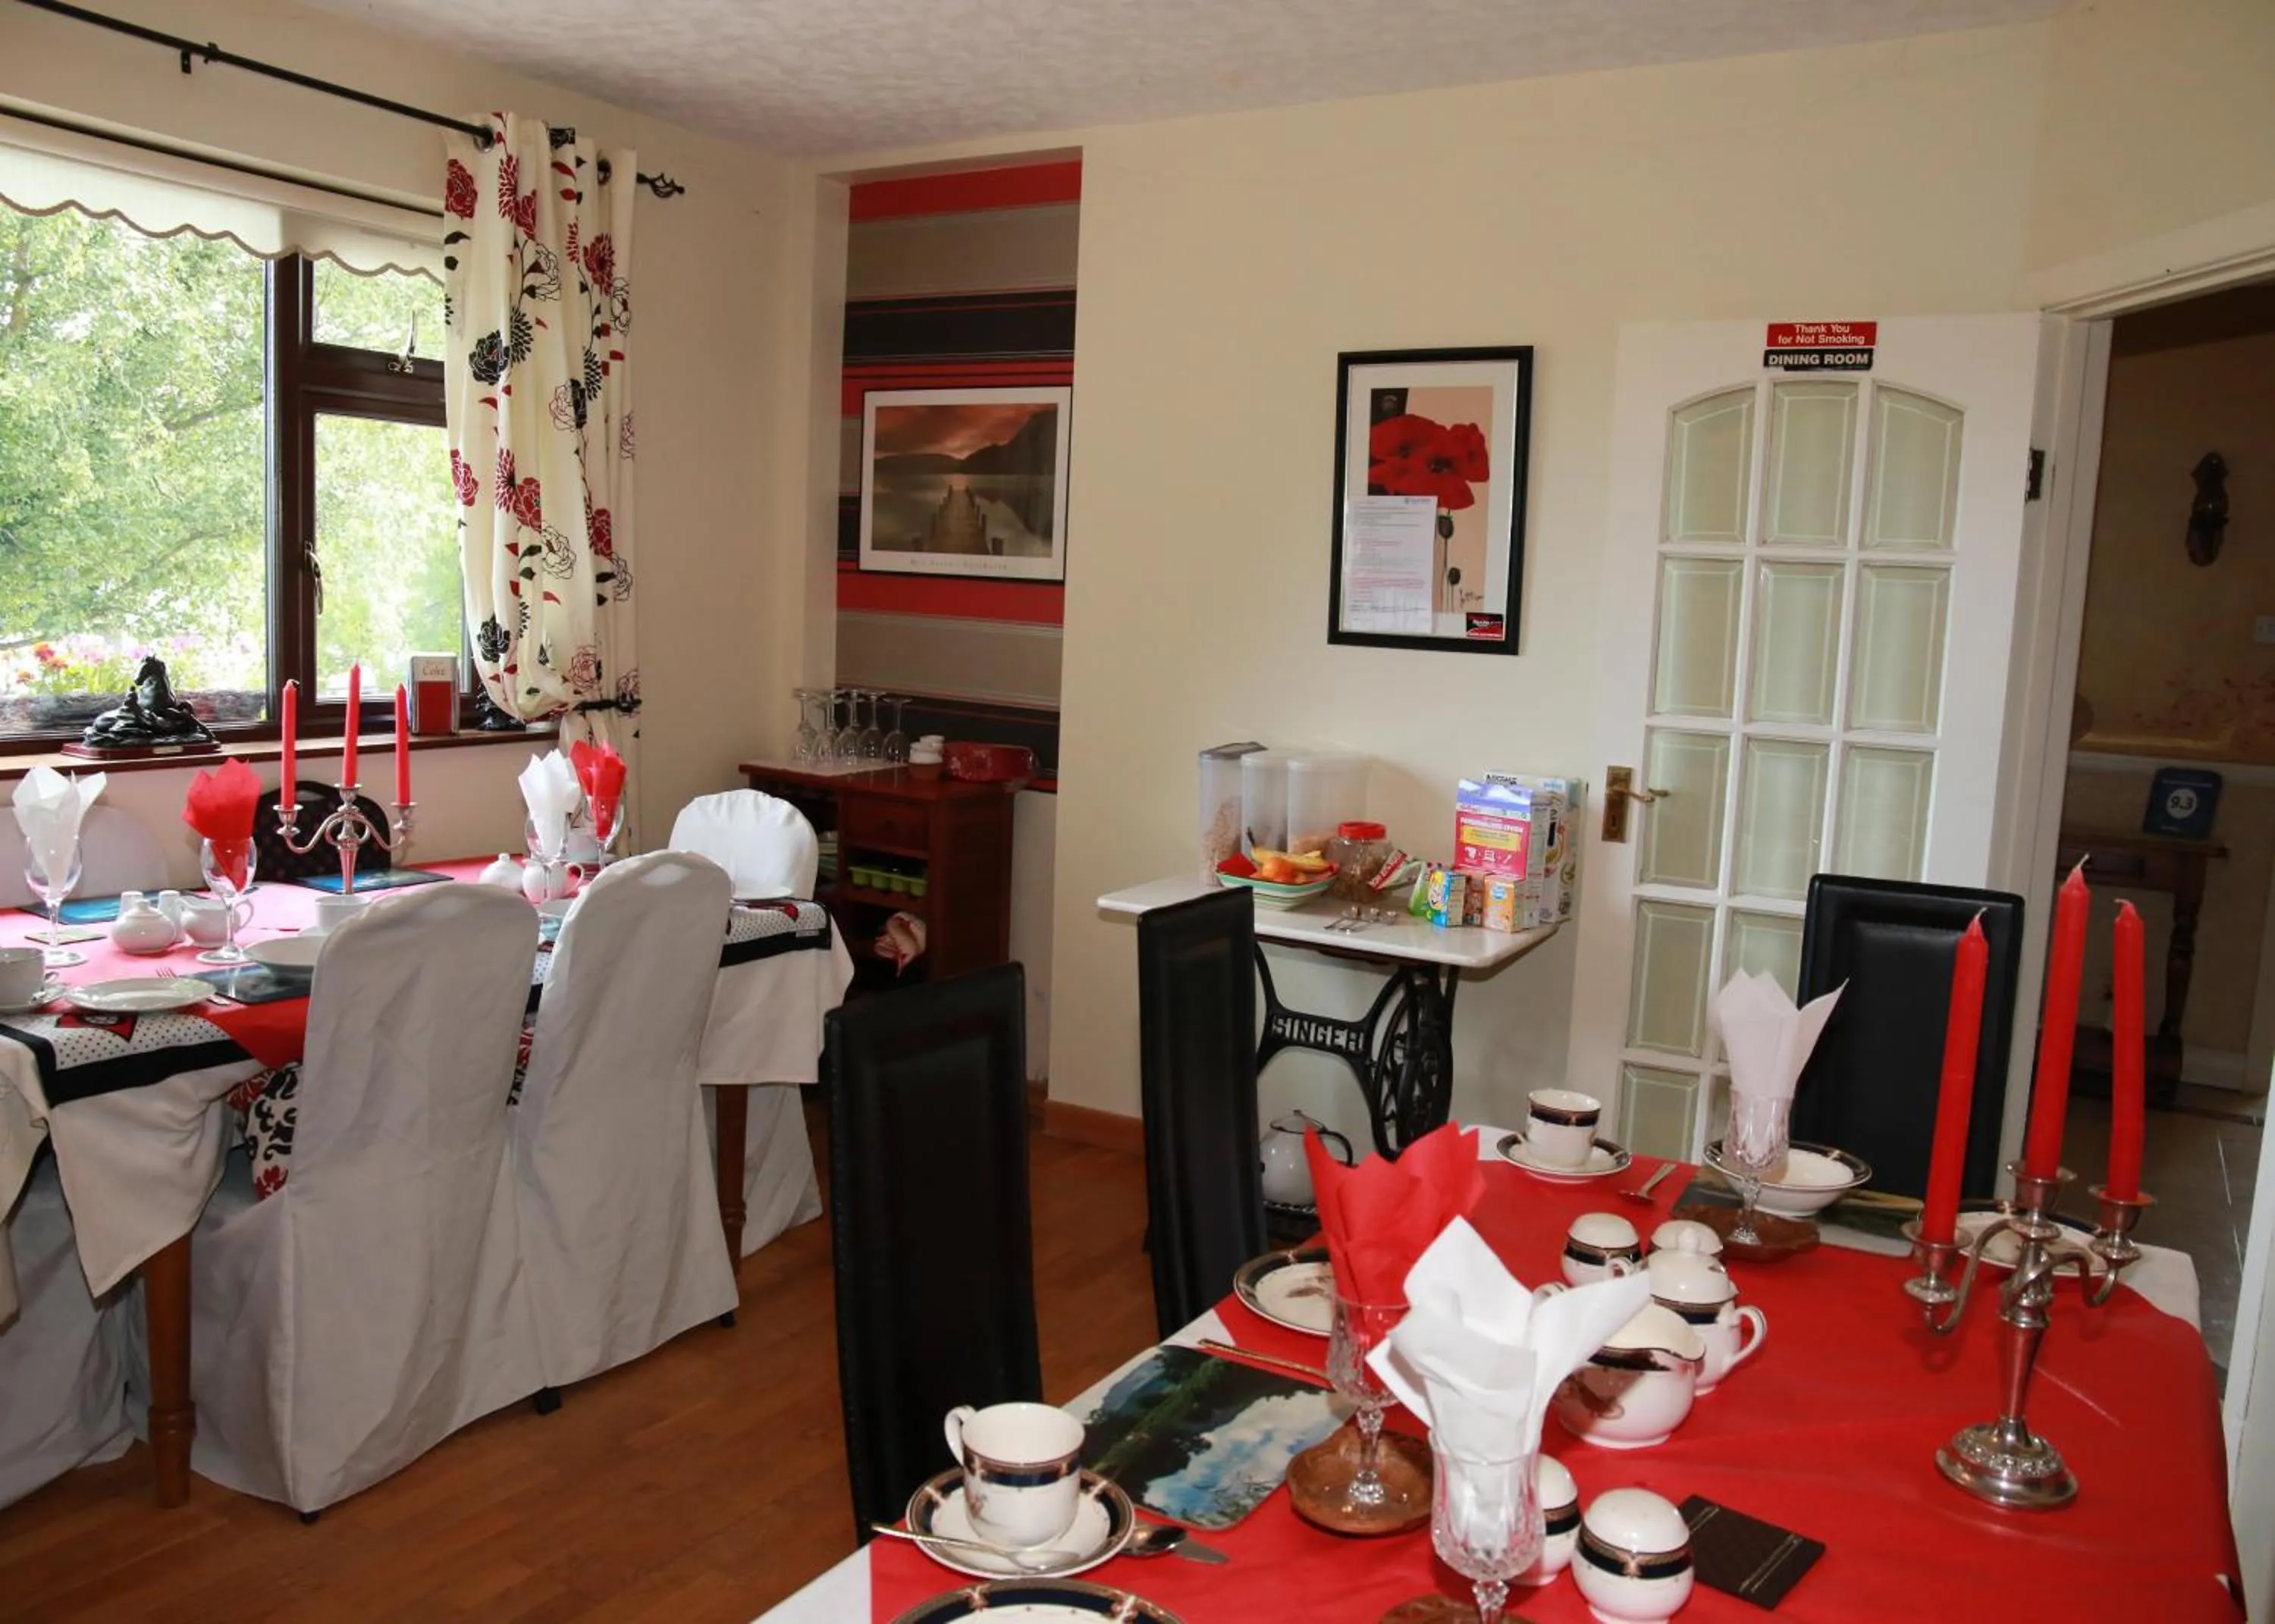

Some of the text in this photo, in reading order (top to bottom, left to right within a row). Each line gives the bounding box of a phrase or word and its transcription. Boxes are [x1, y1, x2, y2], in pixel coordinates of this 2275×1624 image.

[1795, 324, 1850, 334] Thank You
[1778, 334, 1866, 345] for Not Smoking
[1768, 353, 1869, 365] DINING ROOM
[1272, 1015, 1366, 1052] SINGER
